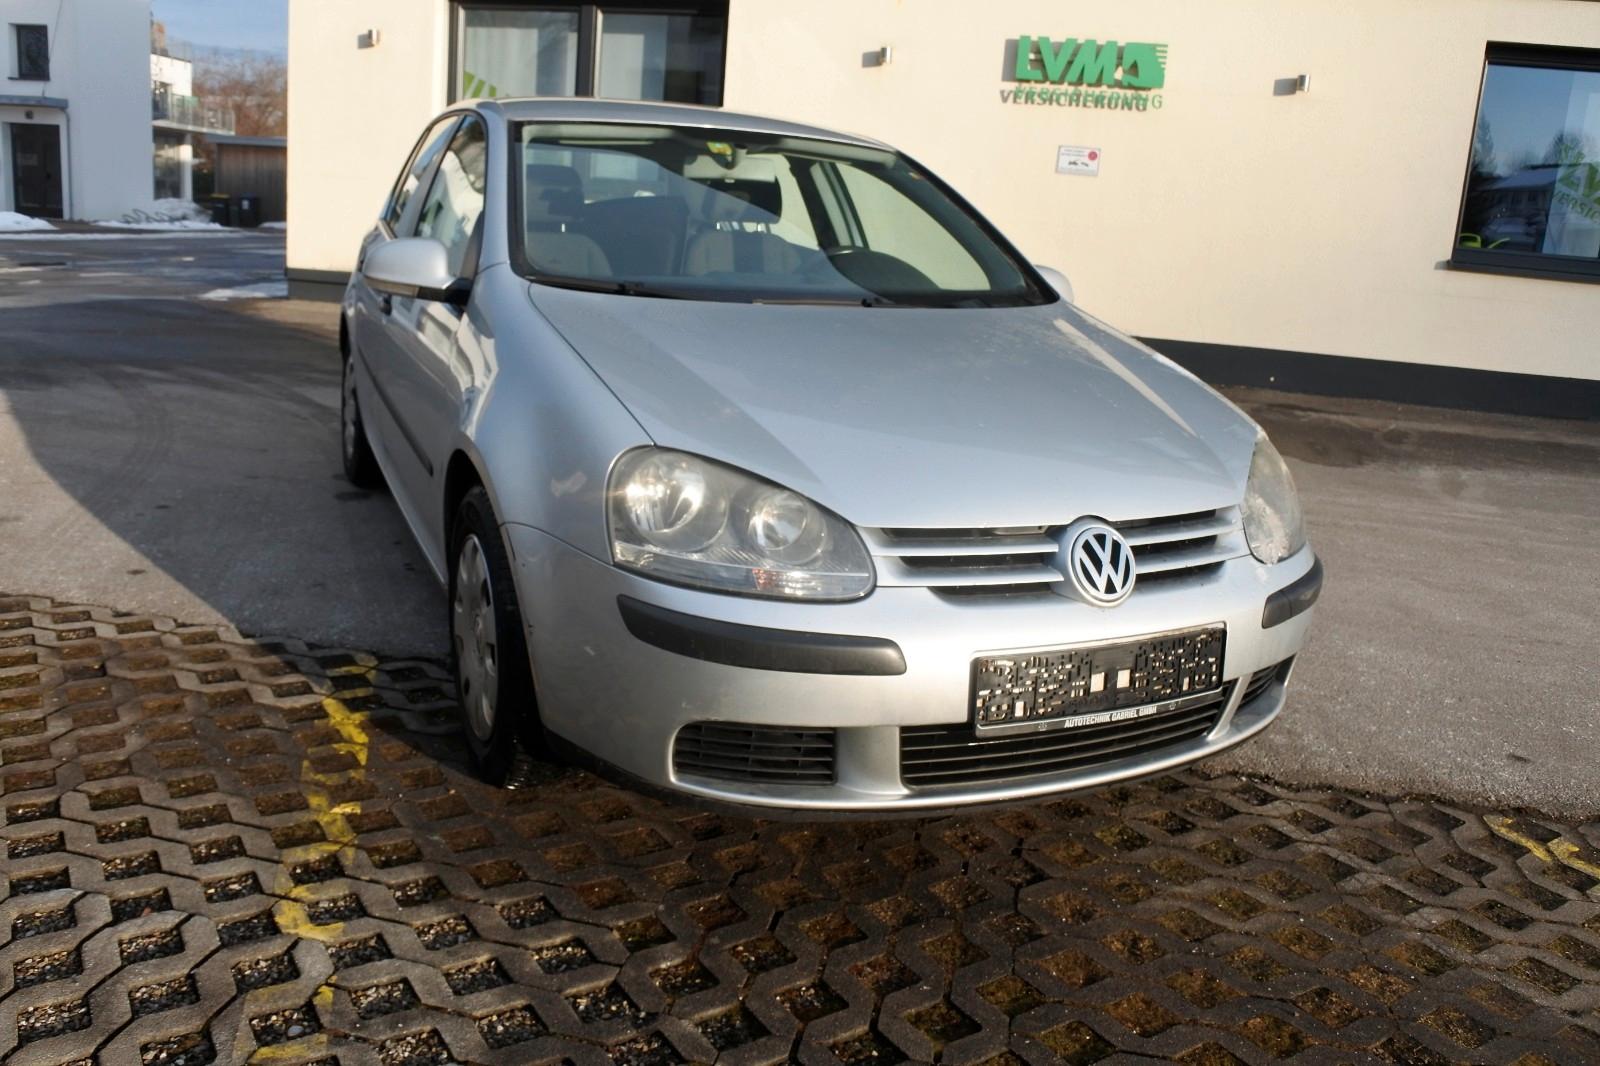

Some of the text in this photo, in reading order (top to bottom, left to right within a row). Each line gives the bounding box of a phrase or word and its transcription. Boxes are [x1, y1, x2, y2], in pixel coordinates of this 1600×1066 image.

[1015, 35, 1118, 86] LVM
[1010, 84, 1163, 111] VERSICHERUNG
[1070, 528, 1132, 597] VW
[1064, 713, 1111, 728] AUTOTECHNIK
[1111, 709, 1138, 721] GABRIEL
